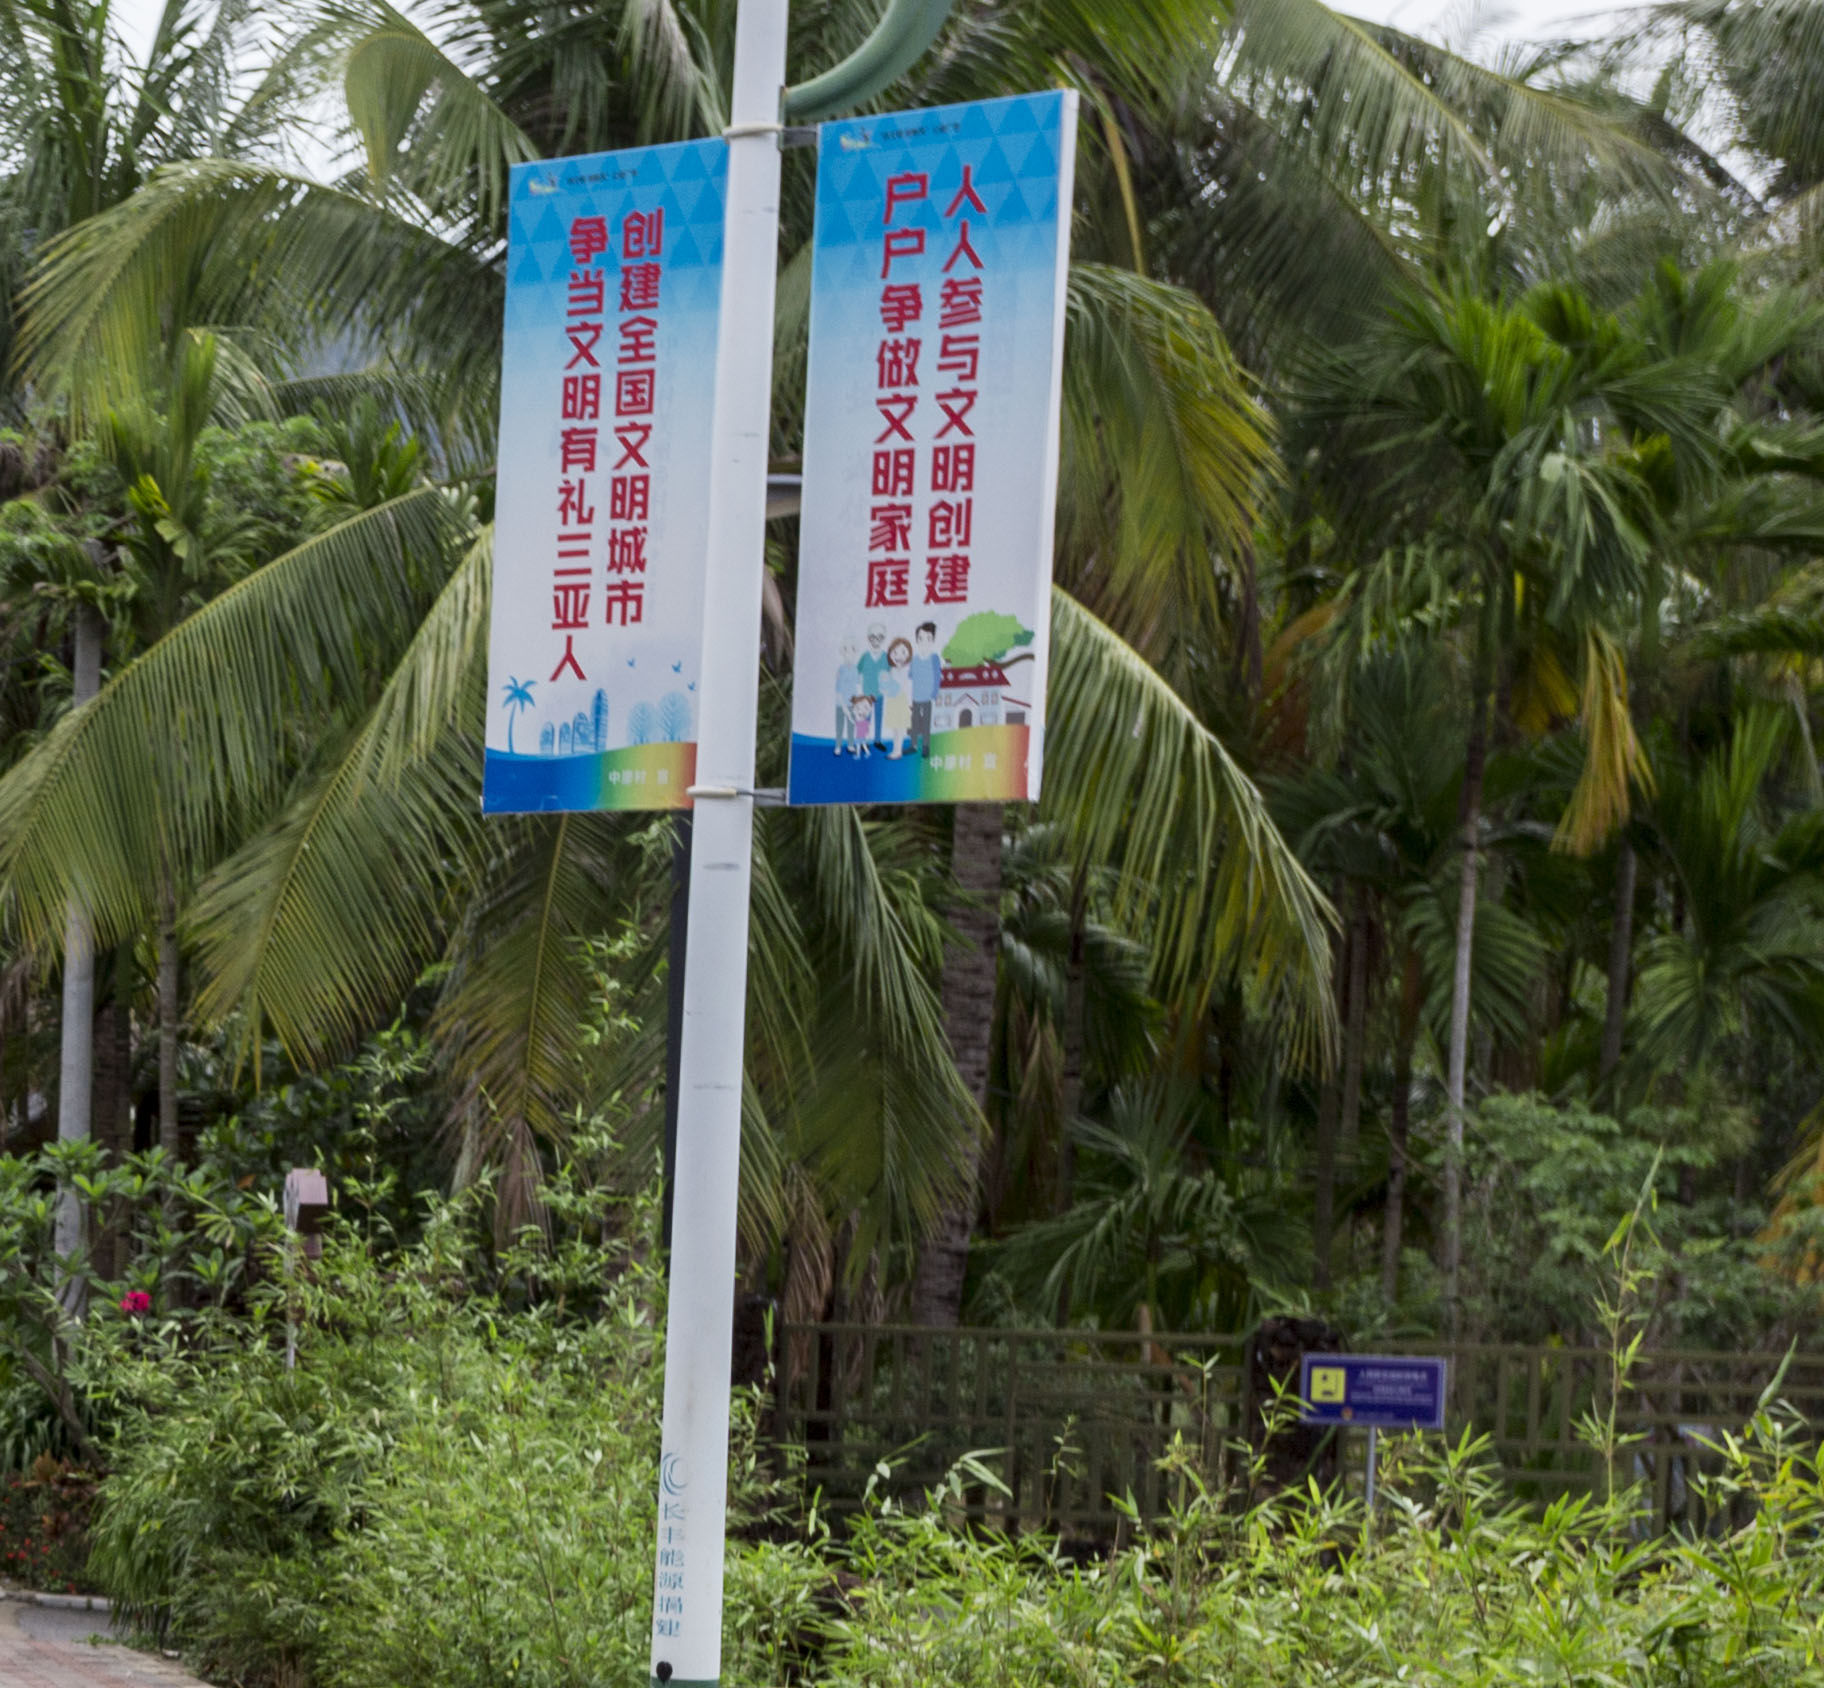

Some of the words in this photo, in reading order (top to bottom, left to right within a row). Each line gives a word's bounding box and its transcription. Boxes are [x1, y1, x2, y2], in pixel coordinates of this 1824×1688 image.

[550, 217, 609, 682] 争当文明有礼三亚人
[605, 208, 663, 627] 创建全国文明城市
[865, 173, 929, 608] 户户争做文明家庭
[924, 165, 986, 604] 人人参与文明创建
